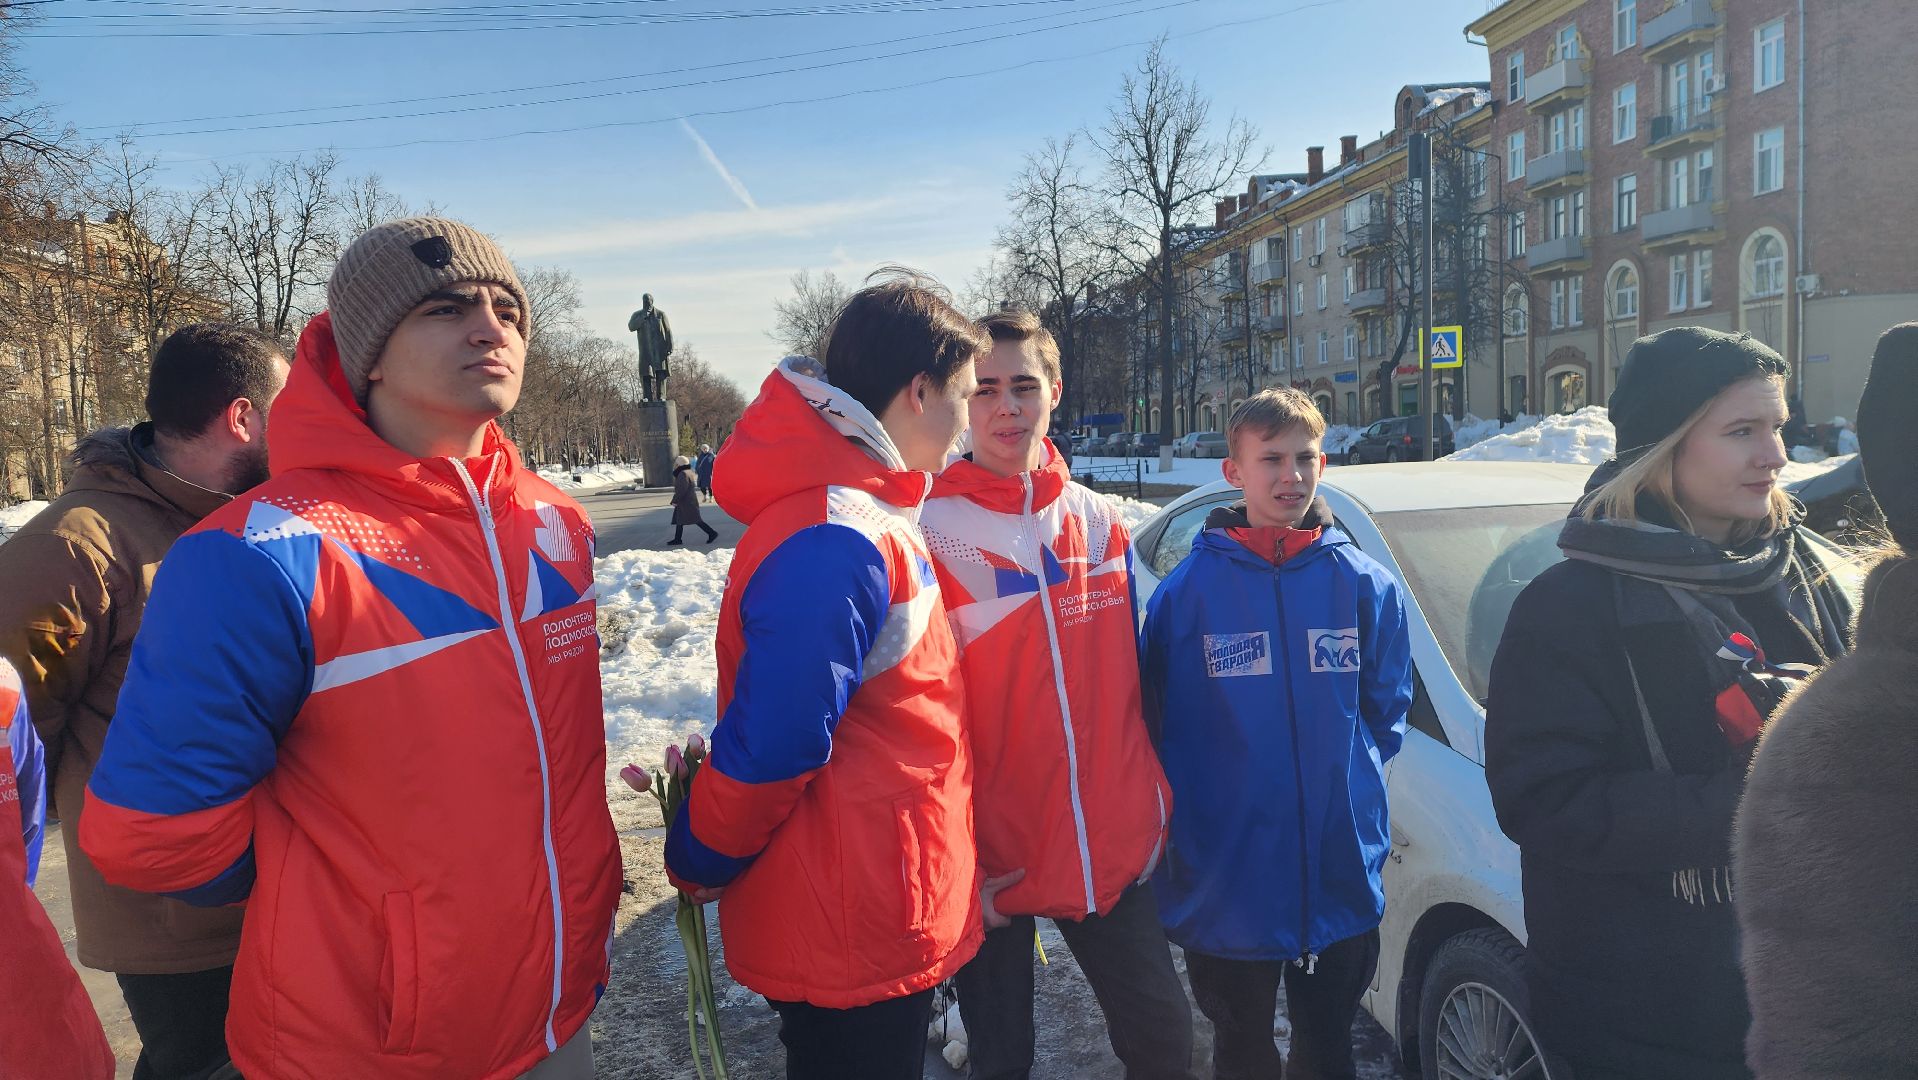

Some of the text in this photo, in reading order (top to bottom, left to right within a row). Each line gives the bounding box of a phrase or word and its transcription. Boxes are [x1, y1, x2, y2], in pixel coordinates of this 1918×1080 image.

[1061, 596, 1125, 617] ПОДОСКОВЬЯ
[543, 611, 593, 636] ВОЛОНТЕРЫ
[548, 653, 563, 665] МЫ
